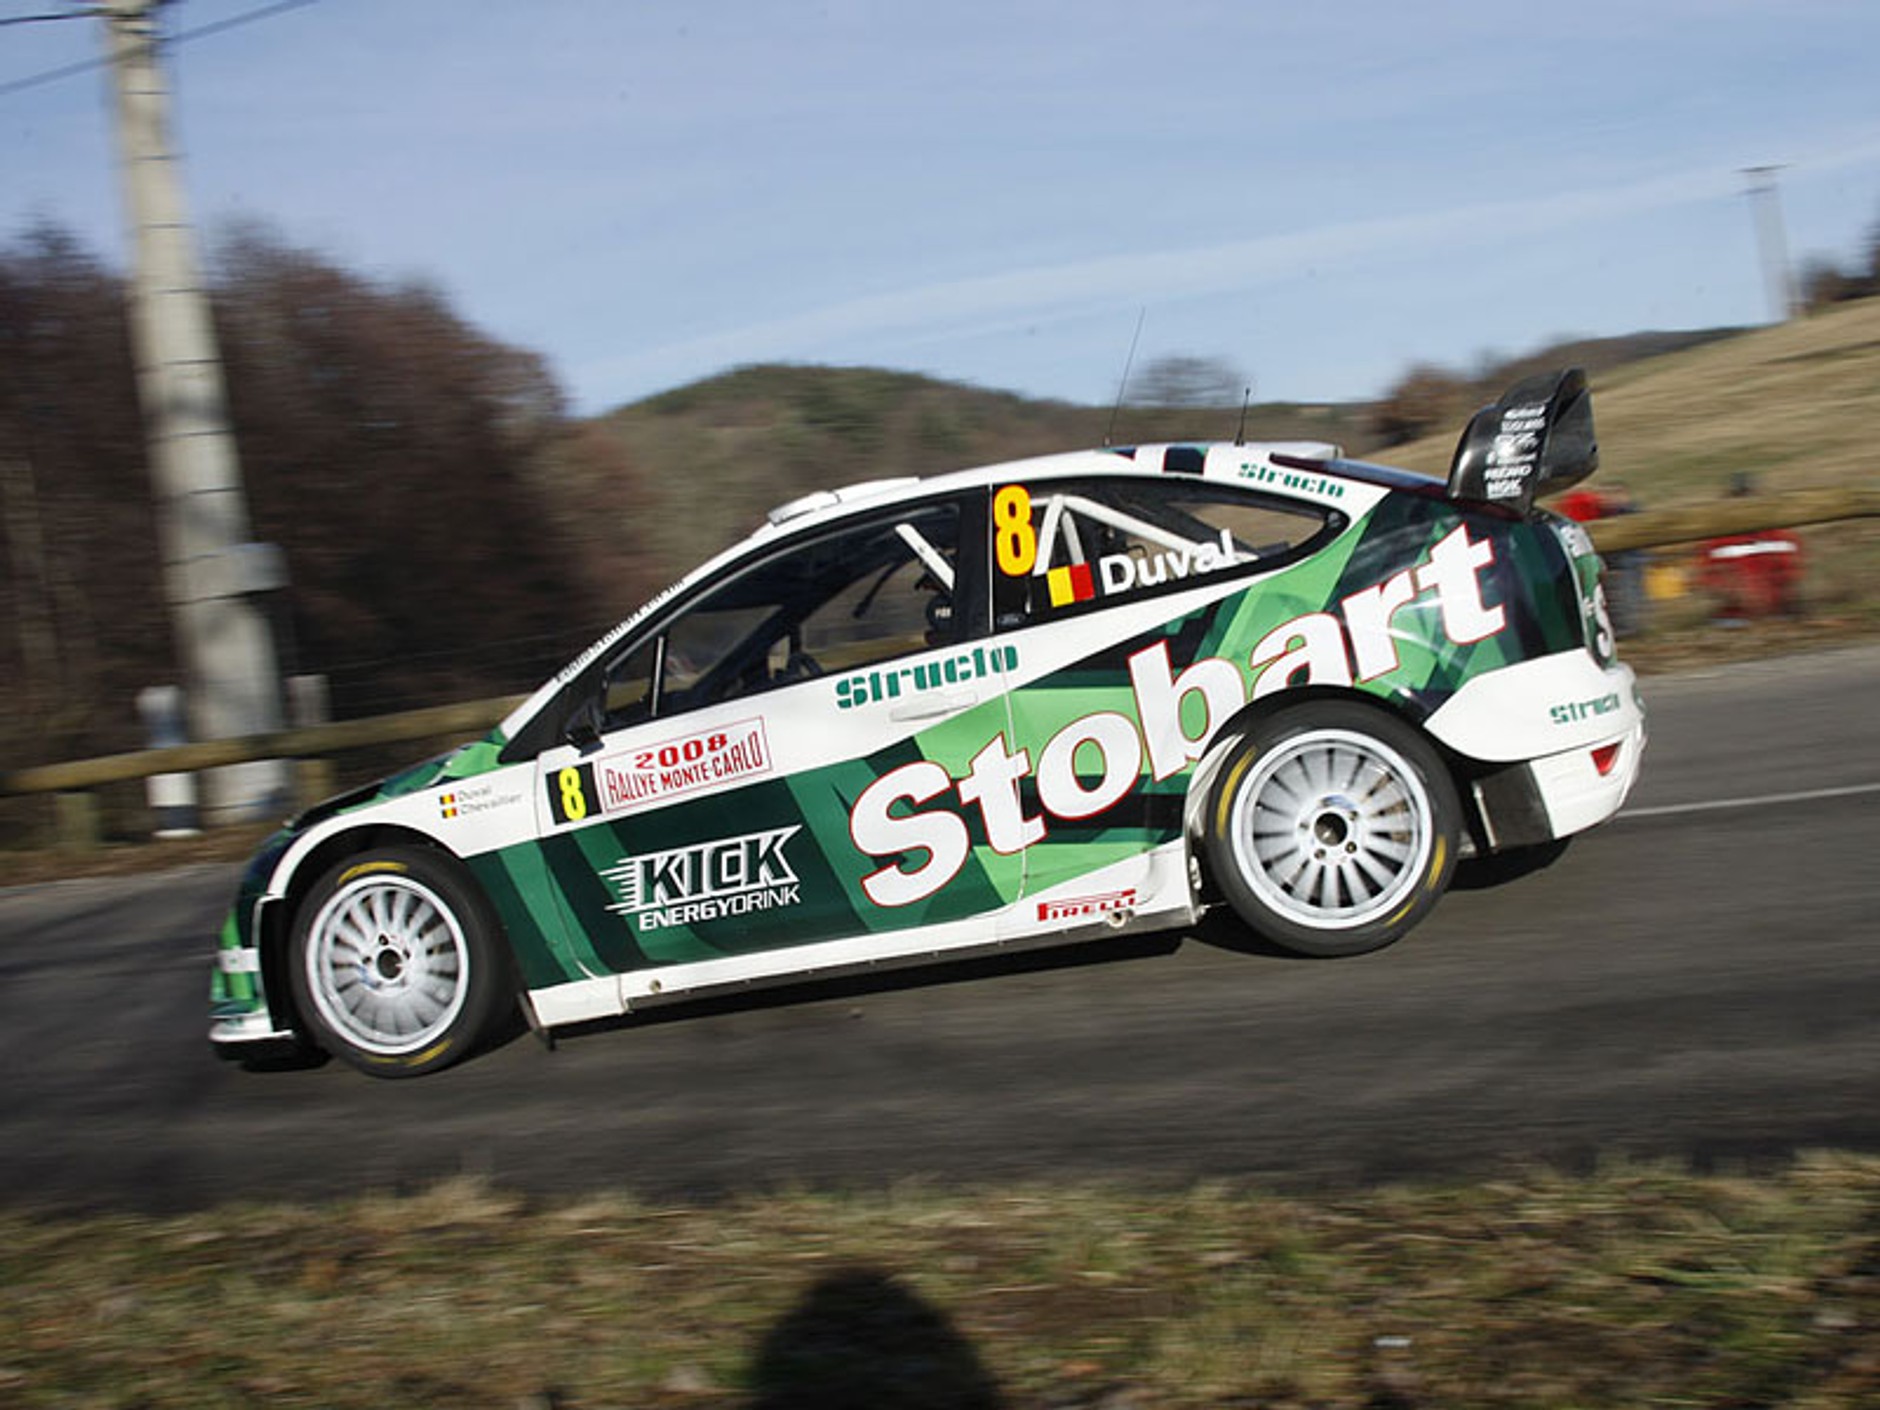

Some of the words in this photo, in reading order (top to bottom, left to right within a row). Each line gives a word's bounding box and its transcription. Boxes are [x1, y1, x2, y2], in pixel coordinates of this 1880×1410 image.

[993, 483, 1038, 577] 8
[1099, 528, 1240, 595] Duval
[849, 522, 1507, 908] Stobart
[634, 732, 728, 770] 2008
[557, 766, 587, 821] 8
[604, 768, 658, 805] RALLYE
[622, 825, 802, 912] KICK
